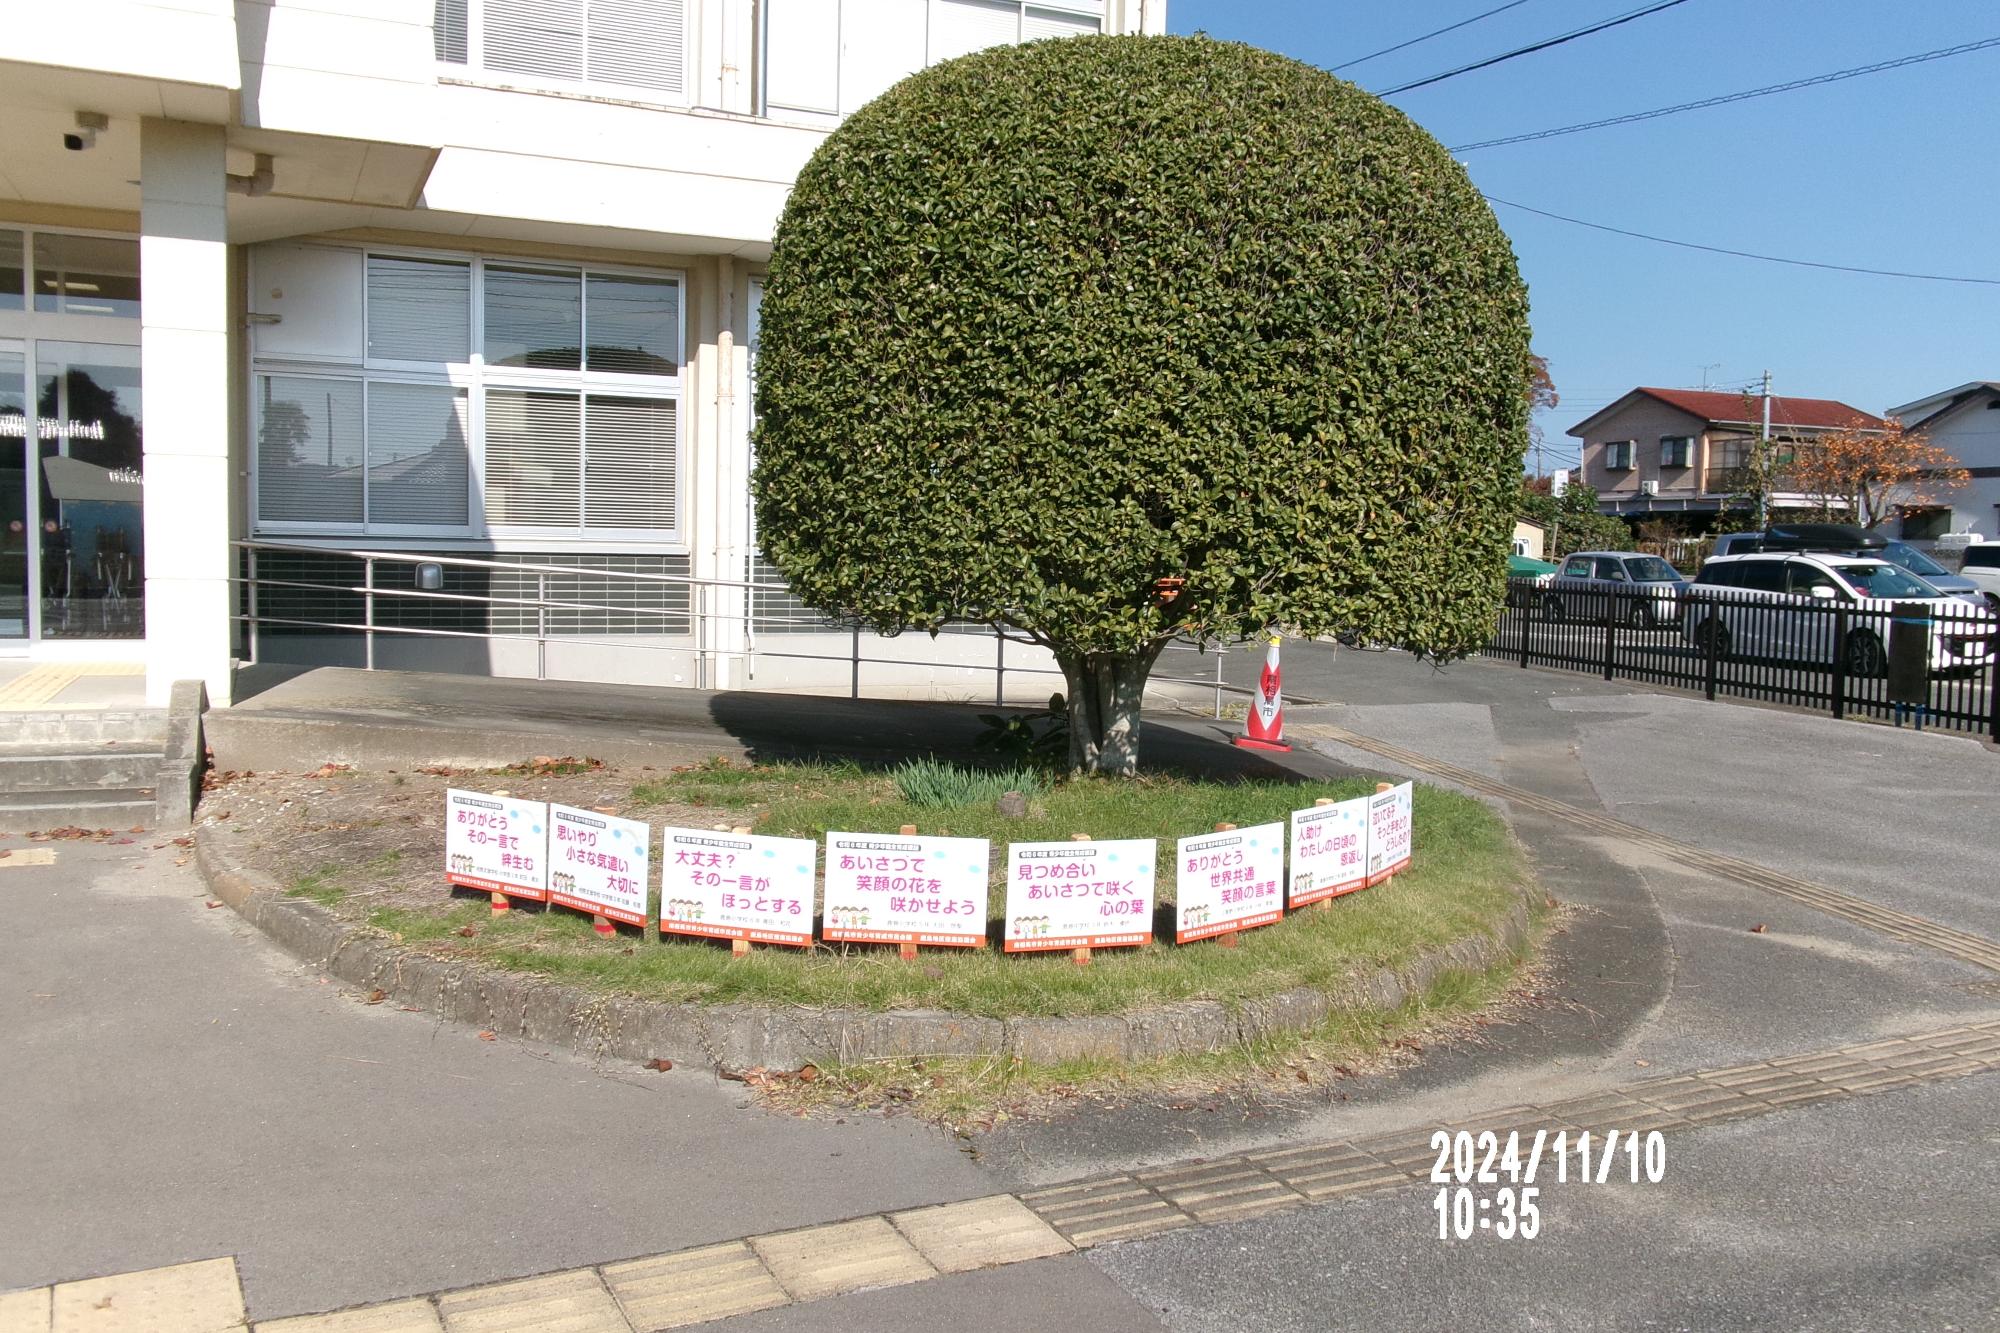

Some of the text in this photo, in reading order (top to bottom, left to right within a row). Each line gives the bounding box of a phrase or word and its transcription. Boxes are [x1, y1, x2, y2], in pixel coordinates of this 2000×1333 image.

[457, 809, 507, 830] ありがとう
[467, 828, 518, 850] その一言で
[557, 824, 596, 847] 思いやり
[1297, 823, 1321, 842] 人助け
[1300, 833, 1356, 859] わたしの日頃の
[1340, 847, 1363, 866] 恩返し
[501, 852, 533, 871] 絆生む
[566, 844, 628, 874] 小さな気遣い
[675, 849, 735, 869] 大丈夫？
[839, 854, 925, 873] あいさつで
[1187, 849, 1242, 873] ありがとう
[690, 870, 770, 892] その一言が
[1017, 862, 1095, 880] 見つめ合い
[1210, 865, 1254, 888] 世界共通
[607, 874, 638, 896] 大切に
[856, 874, 941, 894] 笑顔の花を
[1028, 880, 1133, 899] あいさつで咲く
[1221, 879, 1276, 905] 笑顔の言葉
[721, 892, 801, 915] ほっとする
[890, 896, 975, 915] 咲かせよう
[1099, 899, 1144, 916] 心の葉
